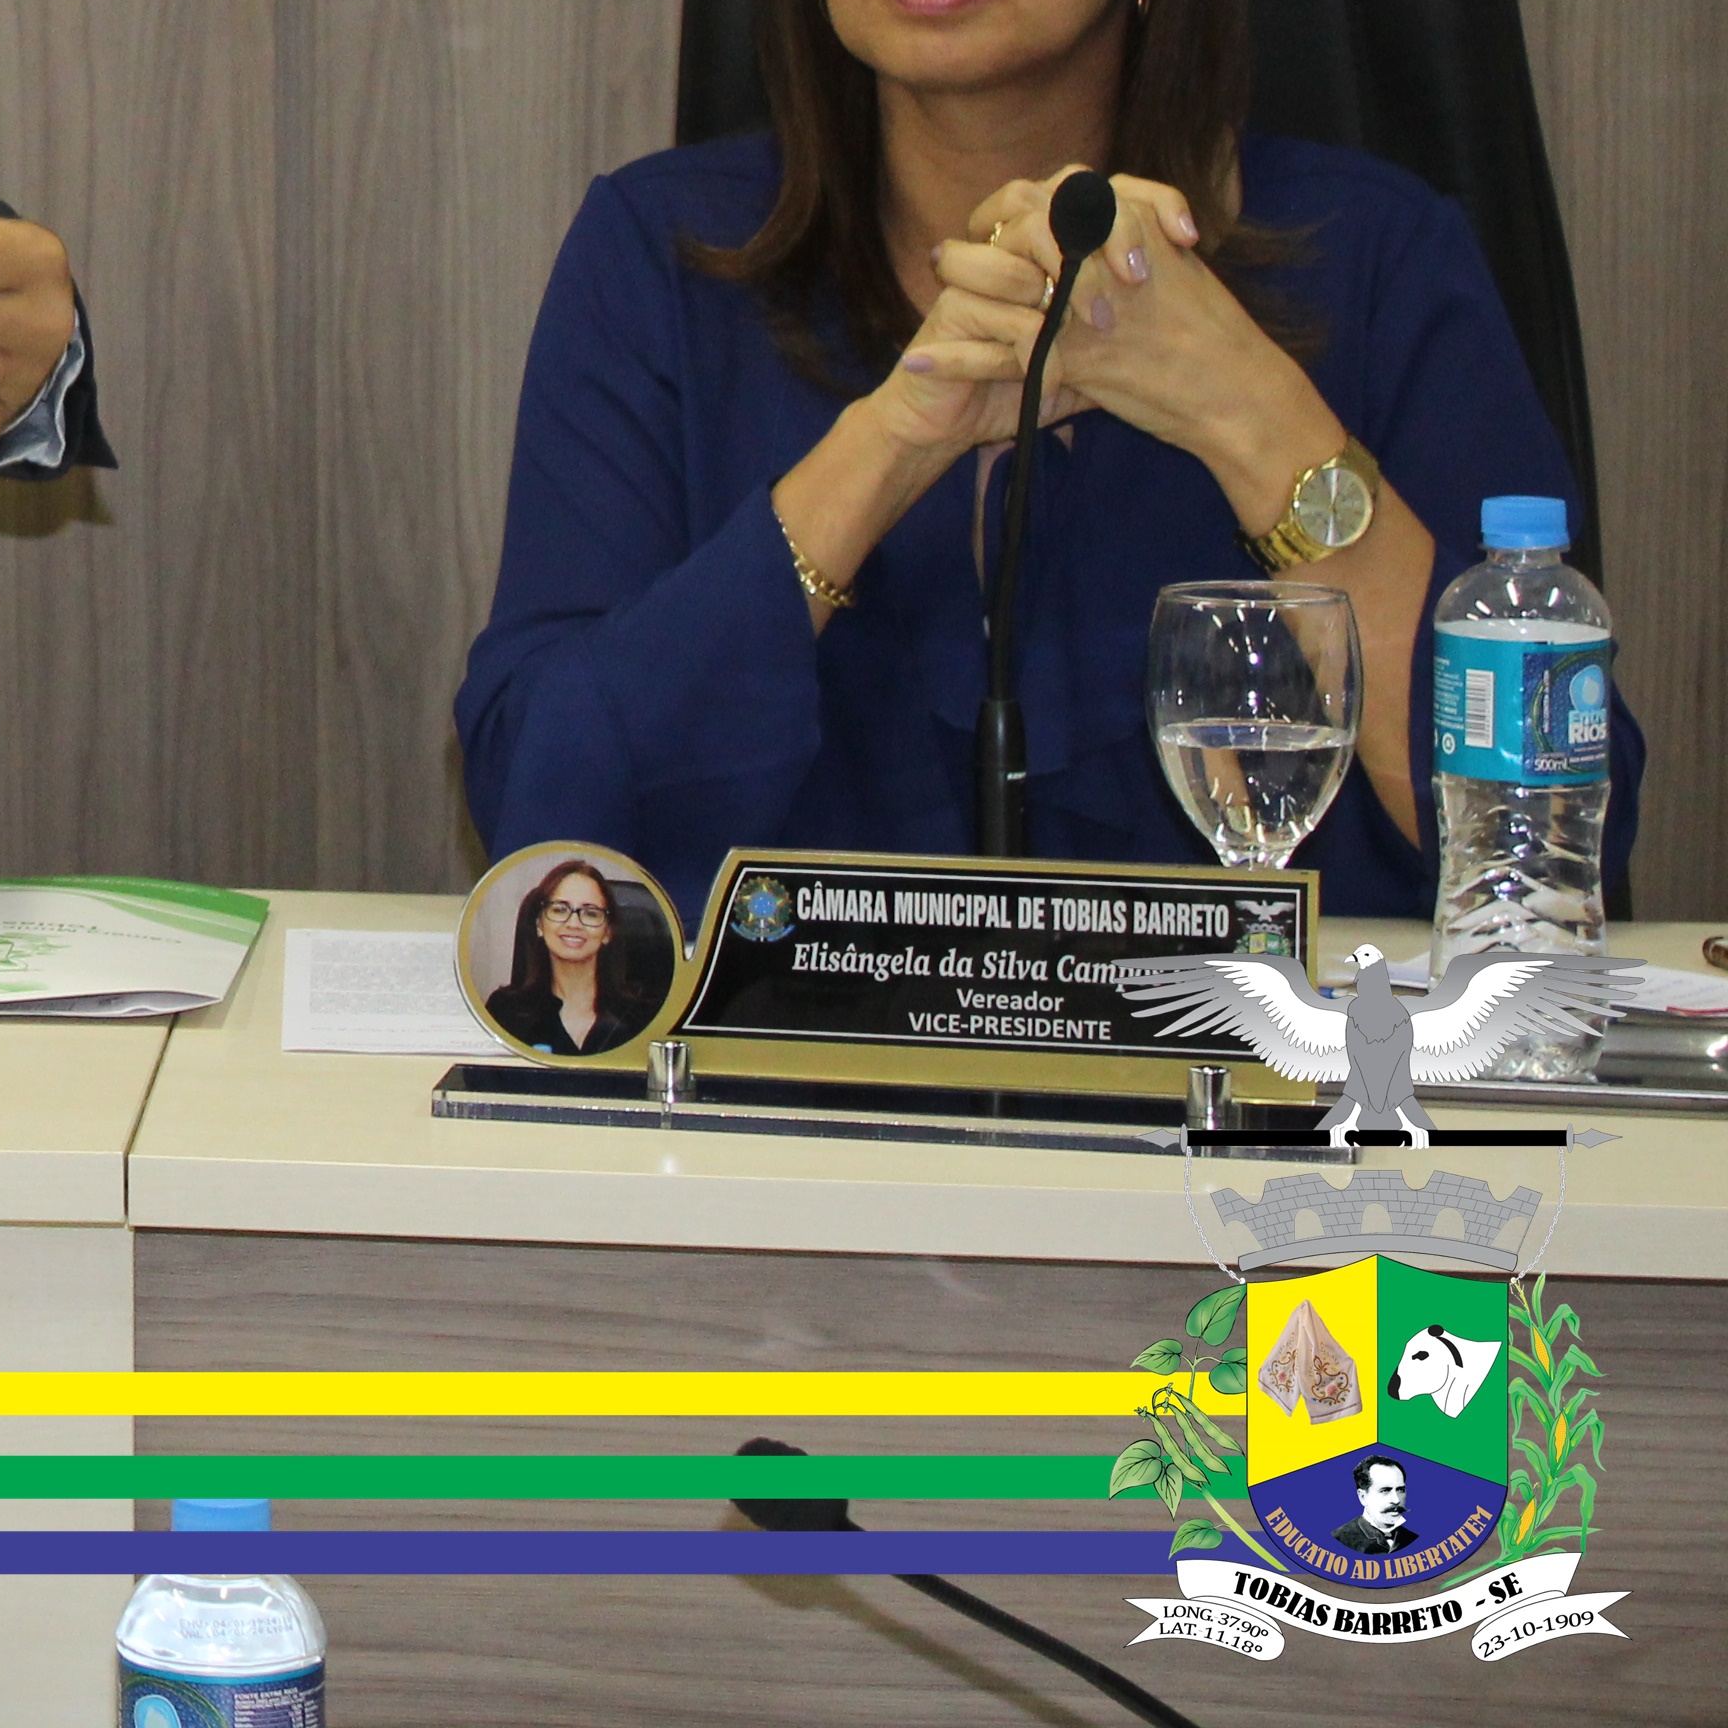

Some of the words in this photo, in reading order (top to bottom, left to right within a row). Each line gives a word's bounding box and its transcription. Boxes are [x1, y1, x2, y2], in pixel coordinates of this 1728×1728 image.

[1534, 758, 1568, 772] 500ml
[796, 881, 888, 925] CÂMARA
[894, 891, 1012, 931] MUNICIPAL
[1017, 896, 1046, 931] DE
[1050, 897, 1128, 935] TOBIAS
[1132, 900, 1230, 939] BARRETO
[792, 942, 931, 982] Elisângela
[938, 946, 973, 978] da
[981, 950, 1048, 981] Silva
[956, 988, 1064, 1013] Vereador
[908, 1011, 1113, 1042] VICE-PRESIDENTE
